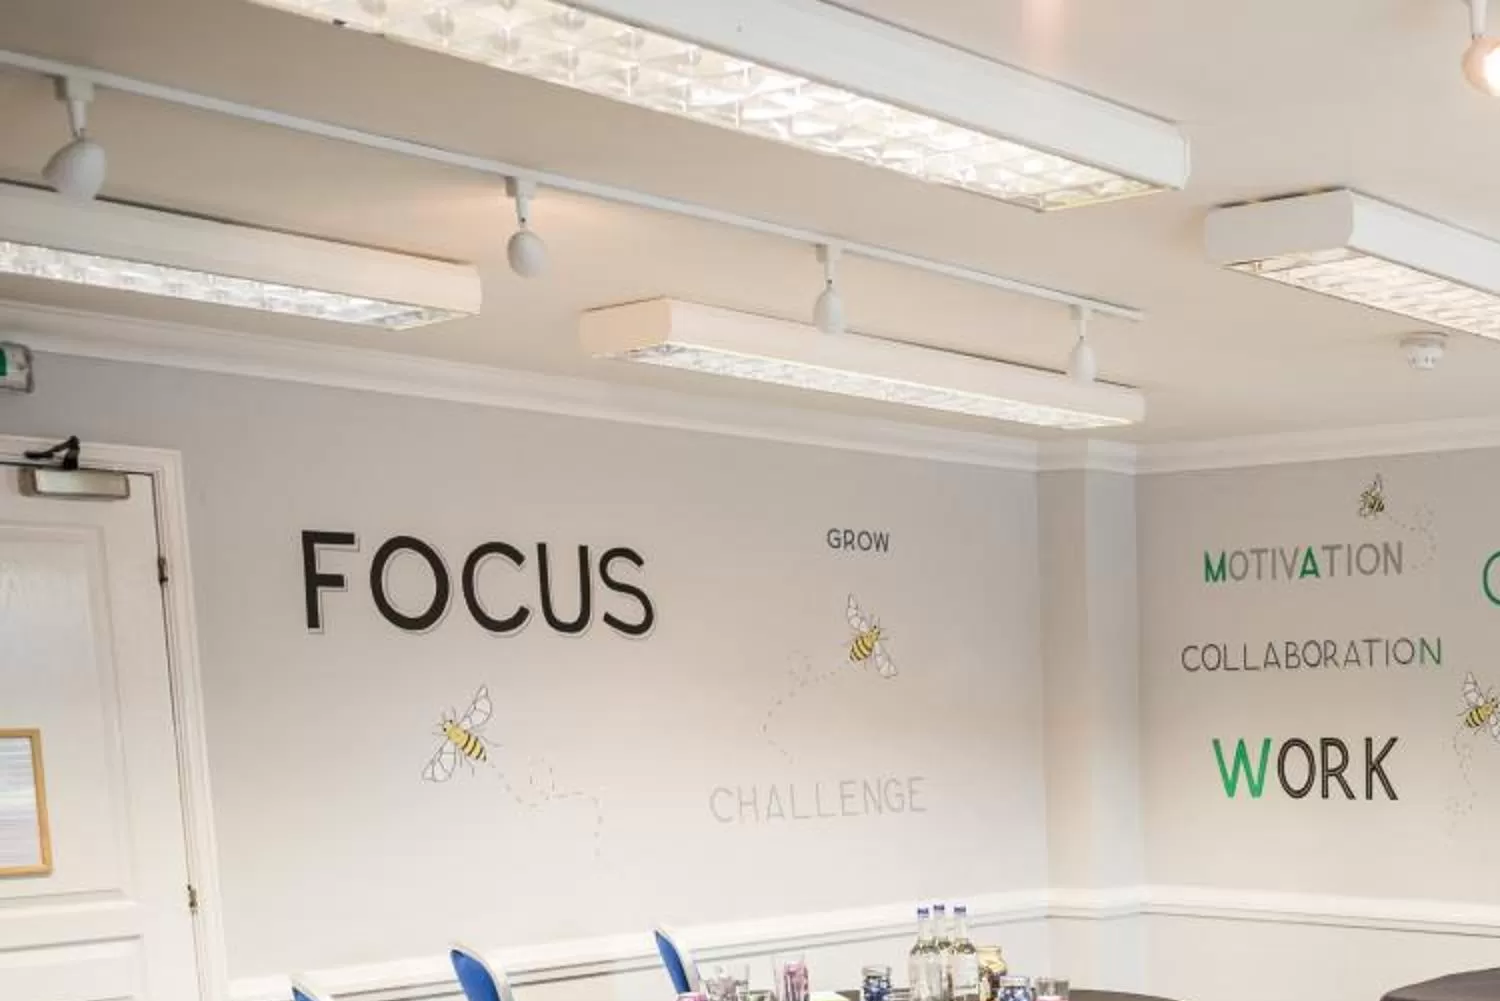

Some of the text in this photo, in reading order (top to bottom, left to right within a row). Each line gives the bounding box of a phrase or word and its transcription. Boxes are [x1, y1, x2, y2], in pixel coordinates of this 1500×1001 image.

[826, 528, 890, 552] GROW
[1203, 541, 1403, 584] MOTIVATION
[301, 529, 656, 637] FOCUS
[1181, 636, 1442, 672] COLLABORATION
[1212, 737, 1398, 801] WORK
[708, 776, 928, 824] CHALLENGE
